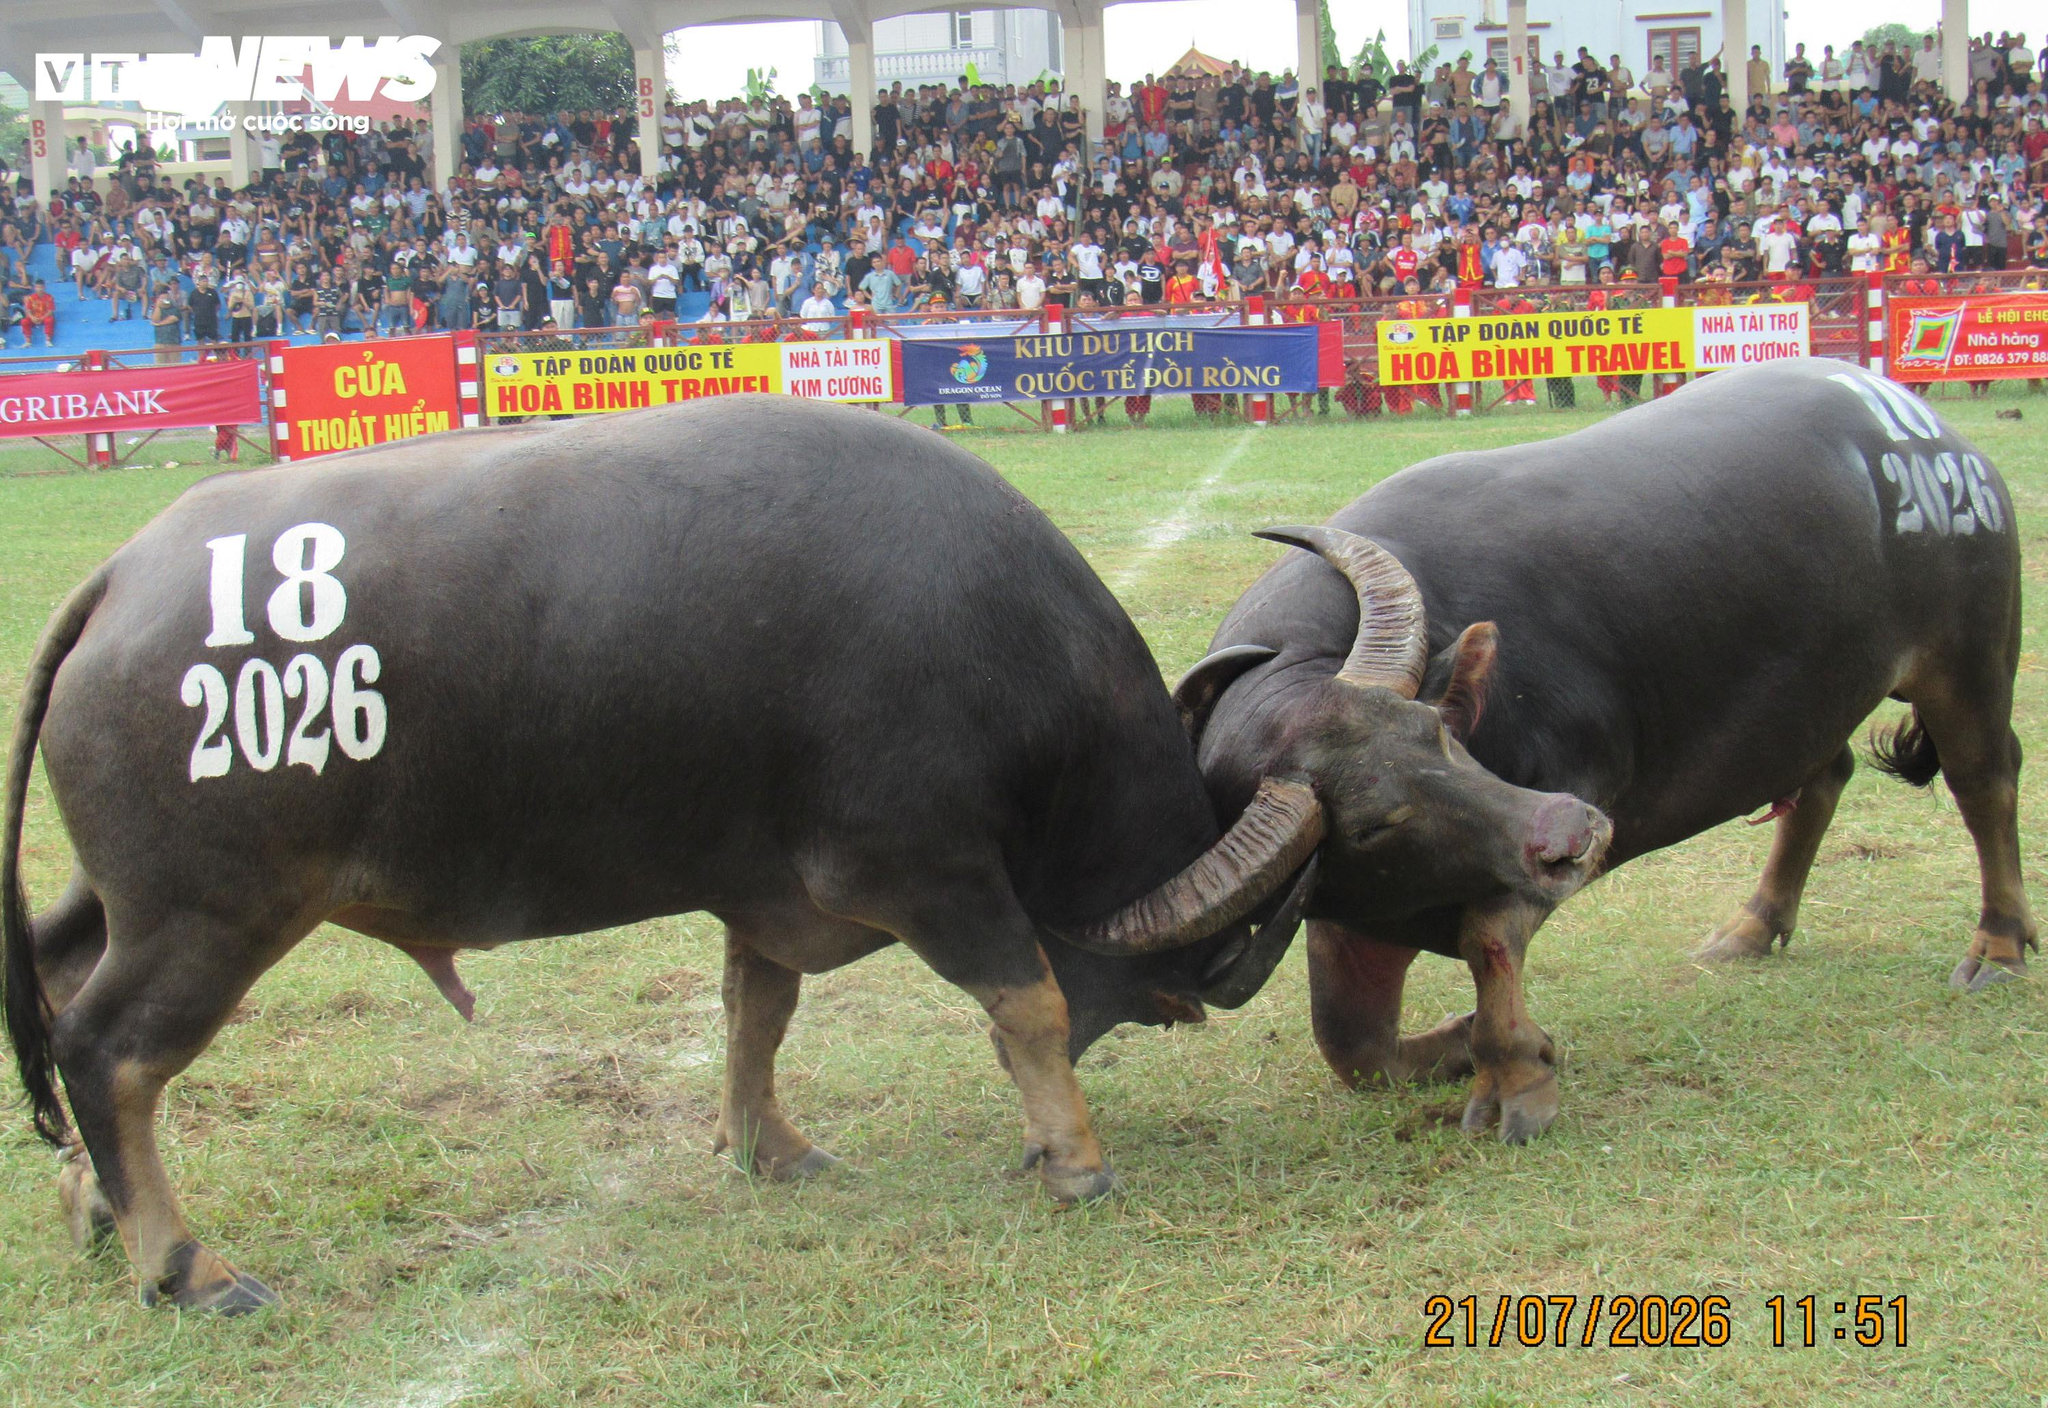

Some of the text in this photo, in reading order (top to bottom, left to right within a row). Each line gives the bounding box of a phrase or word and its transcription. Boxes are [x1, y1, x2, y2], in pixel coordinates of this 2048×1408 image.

[1429, 312, 1645, 346] TẬP ĐOÀN QUỐC TẾ
[1702, 310, 1799, 335] NHÀ TÀI TRỢ
[1997, 308, 2021, 325] HỘI
[1015, 331, 1195, 359] KHU DU LỊCH
[1703, 341, 1800, 364] KIM CƯƠNG
[1967, 332, 2040, 348] Nhà hàng
[334, 350, 408, 399] CỬA
[533, 347, 736, 380] TẬP ĐOÀN QUỐC TẾ
[789, 346, 882, 370] NHÀ TÀI TRỢ
[1391, 341, 1686, 381] HOÀ BÌNH TRAVEL
[1954, 351, 2048, 366] ĐT: 0826 379 88
[790, 374, 884, 398] KIM CƯƠNG
[938, 385, 1003, 396] DRAGON OCEAN
[1015, 356, 1281, 398] QUỐC TẾ ĐỒI RỒNG
[0, 389, 169, 424] GRIBANK
[498, 379, 563, 413] HOÀ
[573, 377, 651, 410] BÌNH
[297, 398, 450, 452] THOÁT HIỂM
[1880, 451, 2004, 538] 2026
[204, 521, 348, 648] 18
[180, 643, 388, 783] 2026
